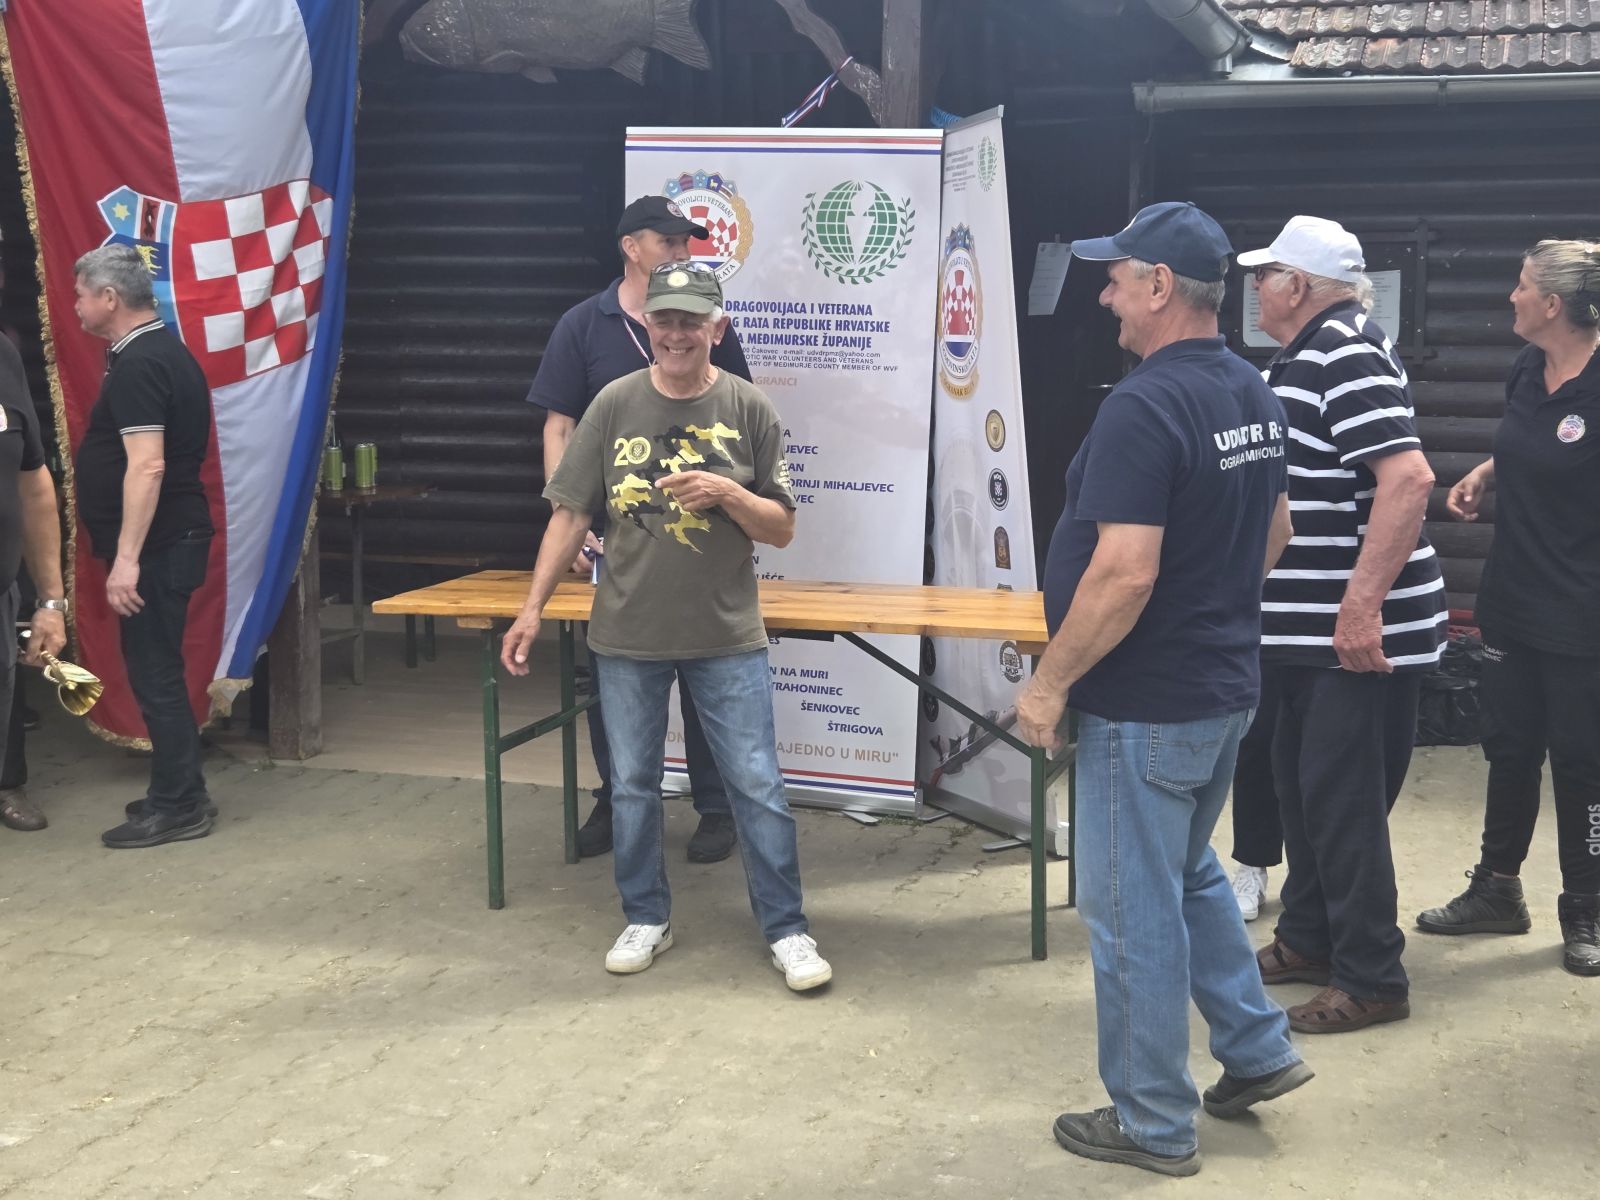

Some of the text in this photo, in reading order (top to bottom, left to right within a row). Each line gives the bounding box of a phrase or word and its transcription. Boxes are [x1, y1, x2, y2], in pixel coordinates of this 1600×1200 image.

[707, 197, 734, 218] VETERANI
[725, 300, 873, 316] DRAGOVOLJACA I VETERANA
[743, 317, 769, 329] RATA
[773, 318, 831, 331] REPUBLIKE
[835, 320, 890, 333] HRVATSKE
[747, 333, 819, 347] MEĐIMURSKE
[822, 333, 872, 351] ŽUPANIJE
[752, 345, 778, 354] Čakovec
[779, 355, 822, 363] VOLUNTEERS
[614, 436, 651, 466] 20
[785, 445, 819, 455] JEVEC
[823, 480, 894, 493] MIHALJEVEC
[780, 667, 797, 677] NA
[799, 668, 829, 679] MURI
[800, 699, 861, 716] ŠENKOVEC
[827, 720, 884, 736] ŠTRIGOVA
[776, 741, 899, 763] AJEDNO U MIRU"
